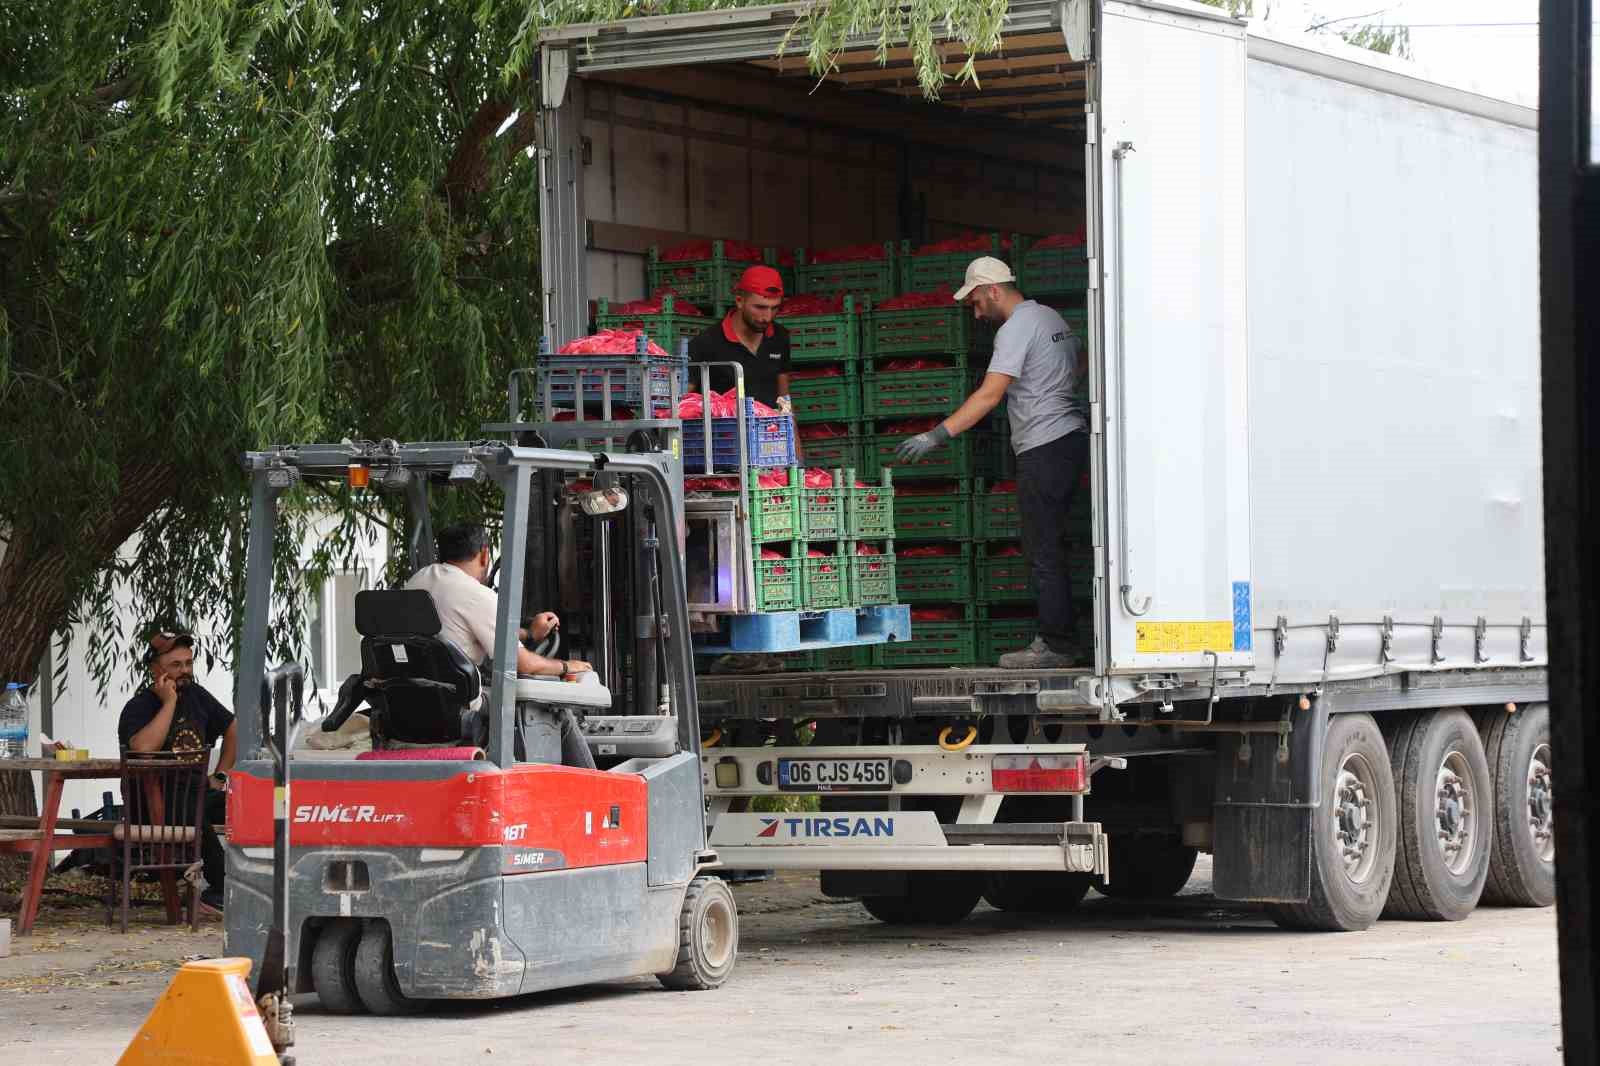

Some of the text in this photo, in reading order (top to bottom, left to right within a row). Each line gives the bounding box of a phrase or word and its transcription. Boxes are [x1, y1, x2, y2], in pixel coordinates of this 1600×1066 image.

[790, 763, 886, 782] 06 CJS 456
[783, 818, 894, 837] TIRSAN
[513, 852, 544, 865] SIMER
